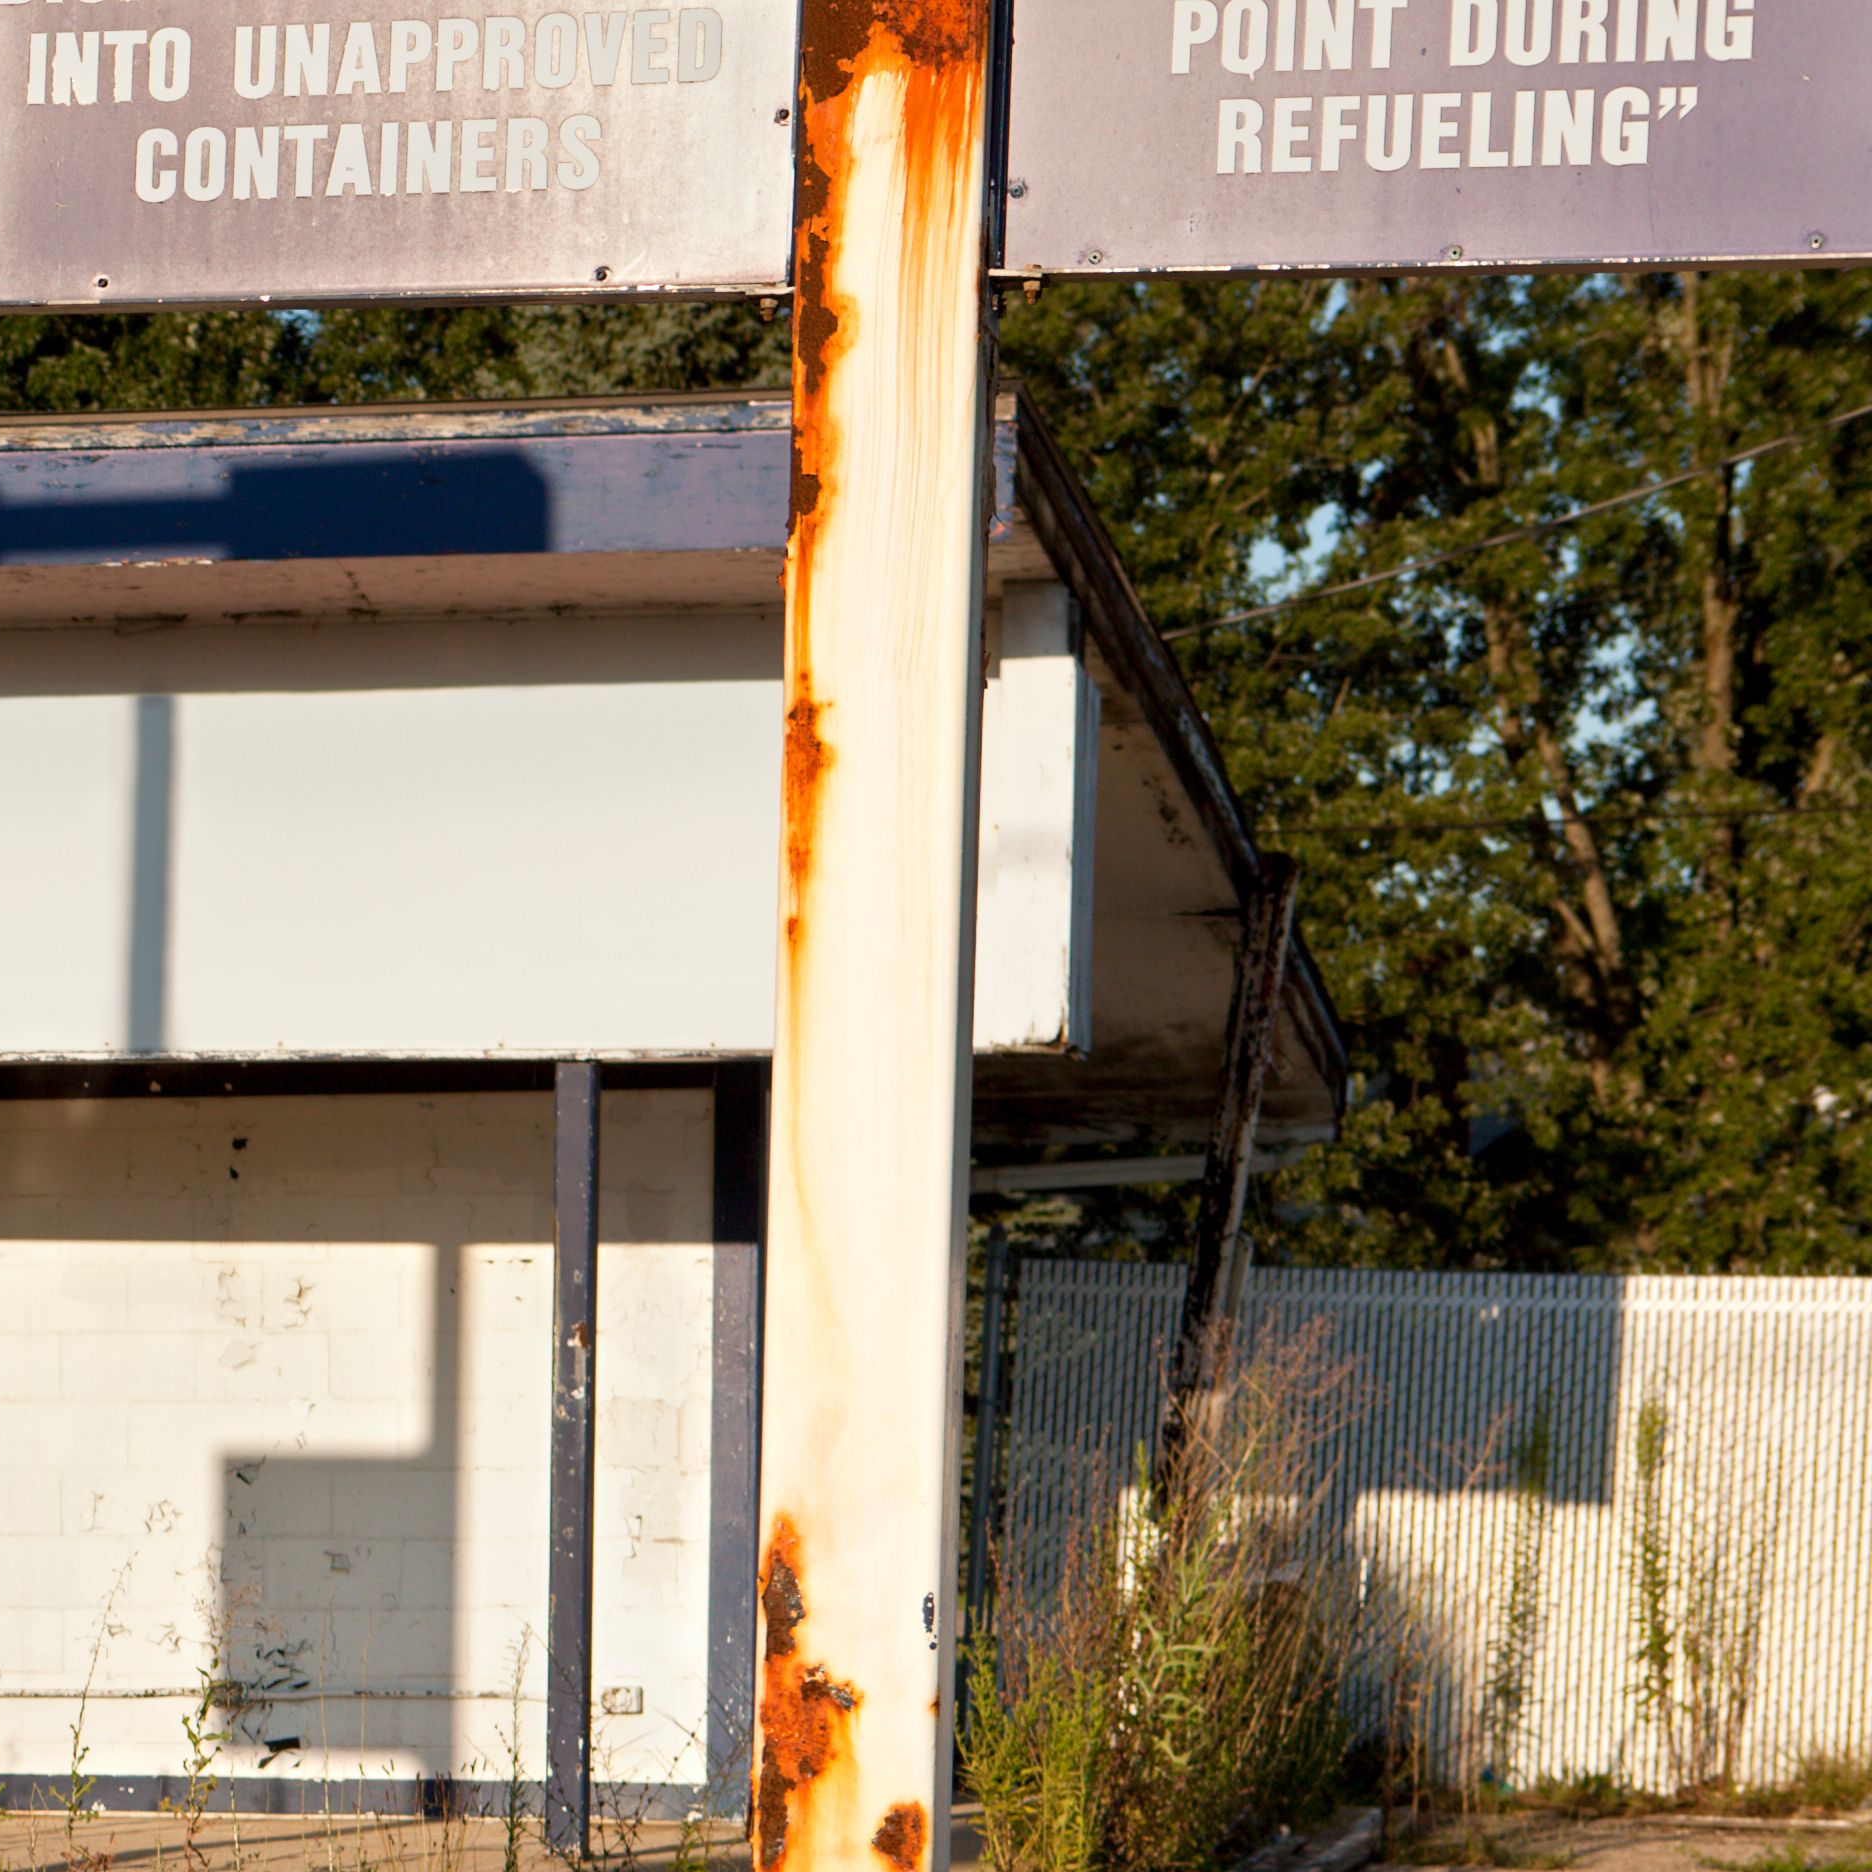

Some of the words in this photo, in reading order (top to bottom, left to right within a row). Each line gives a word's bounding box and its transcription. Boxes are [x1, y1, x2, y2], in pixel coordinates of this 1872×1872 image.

[25, 27, 192, 106] INTO
[233, 7, 724, 100] UNAPPROVED
[1171, 0, 1409, 77] POINT
[1449, 0, 1754, 67] DURING
[134, 113, 603, 203] CONTAINERS
